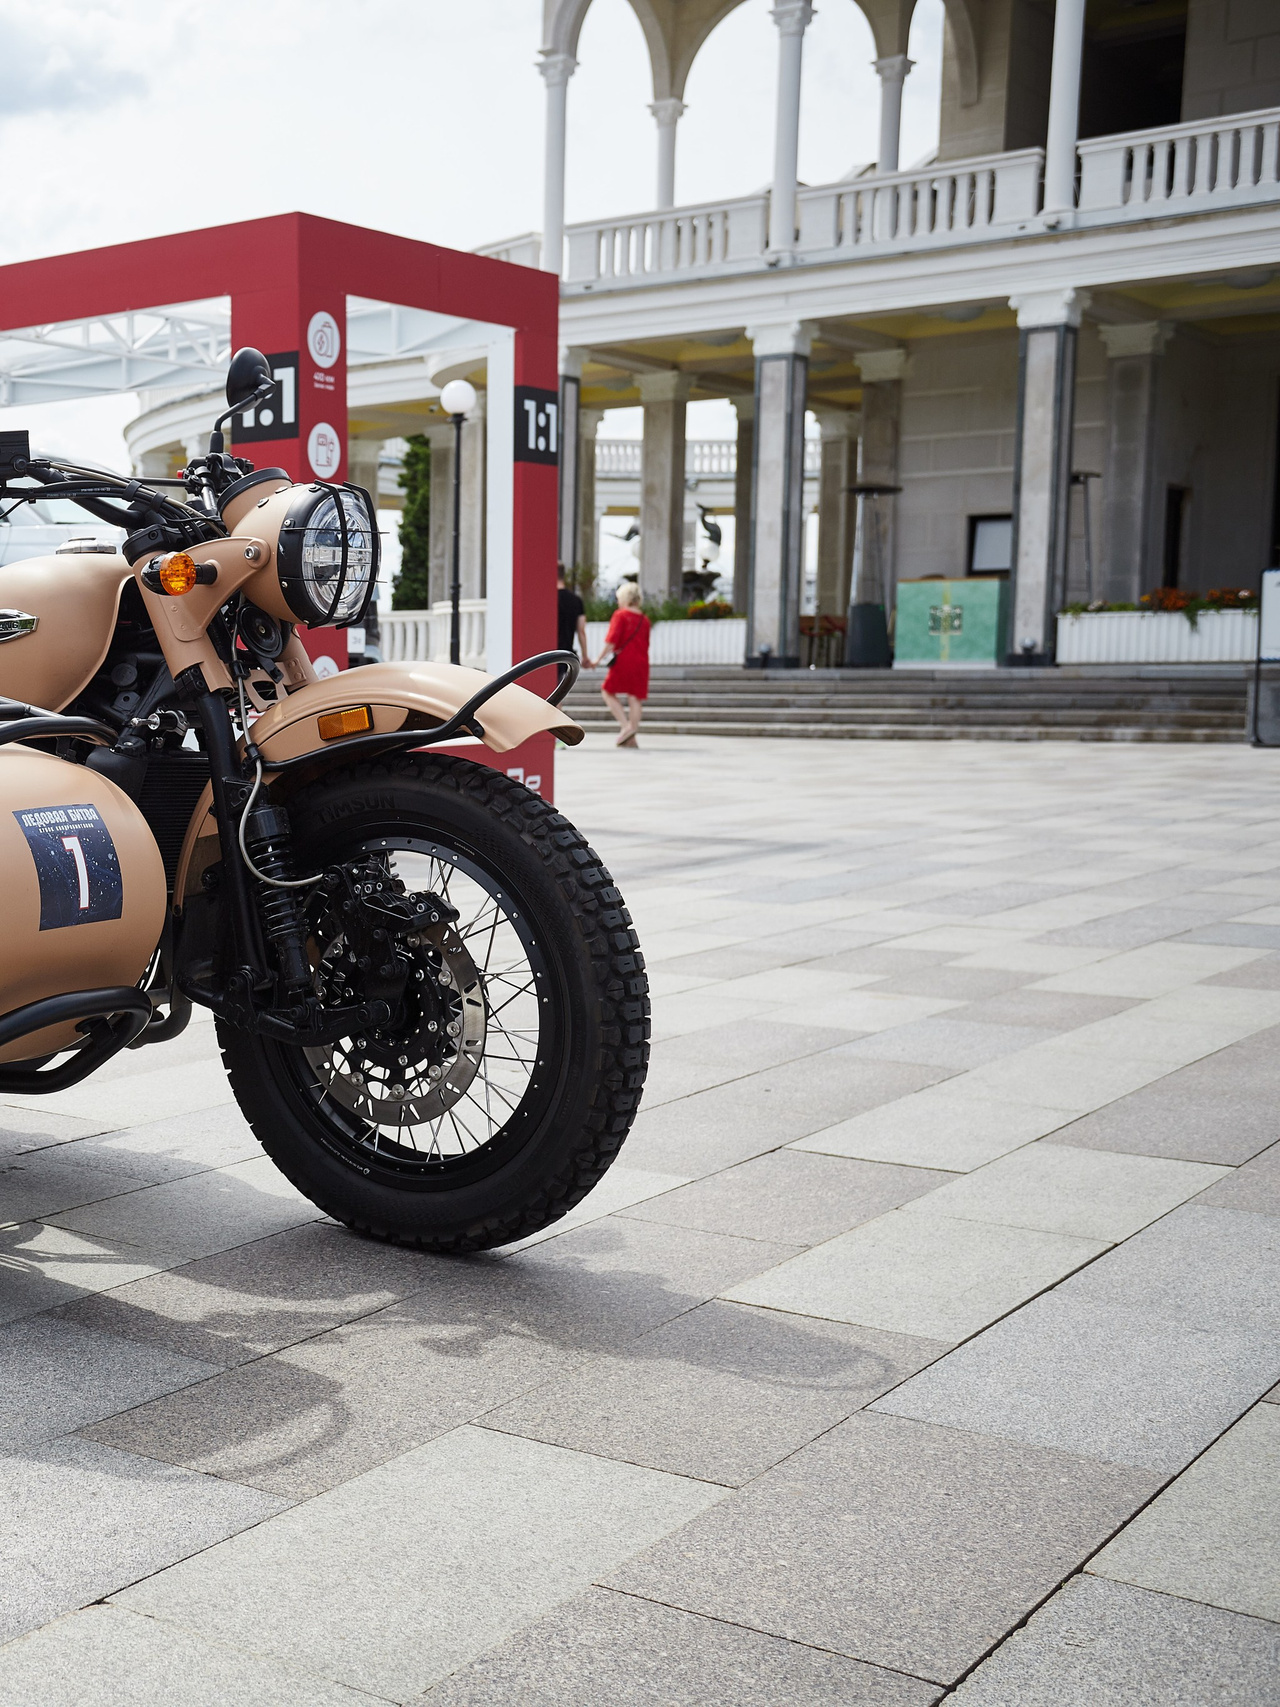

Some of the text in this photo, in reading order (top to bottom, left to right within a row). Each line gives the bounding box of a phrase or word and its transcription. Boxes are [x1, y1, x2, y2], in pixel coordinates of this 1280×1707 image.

[523, 398, 557, 453] 1:1
[21, 810, 68, 828] ЛЕДОВАЯ
[67, 808, 99, 821] БИТВА
[61, 834, 89, 910] 1
